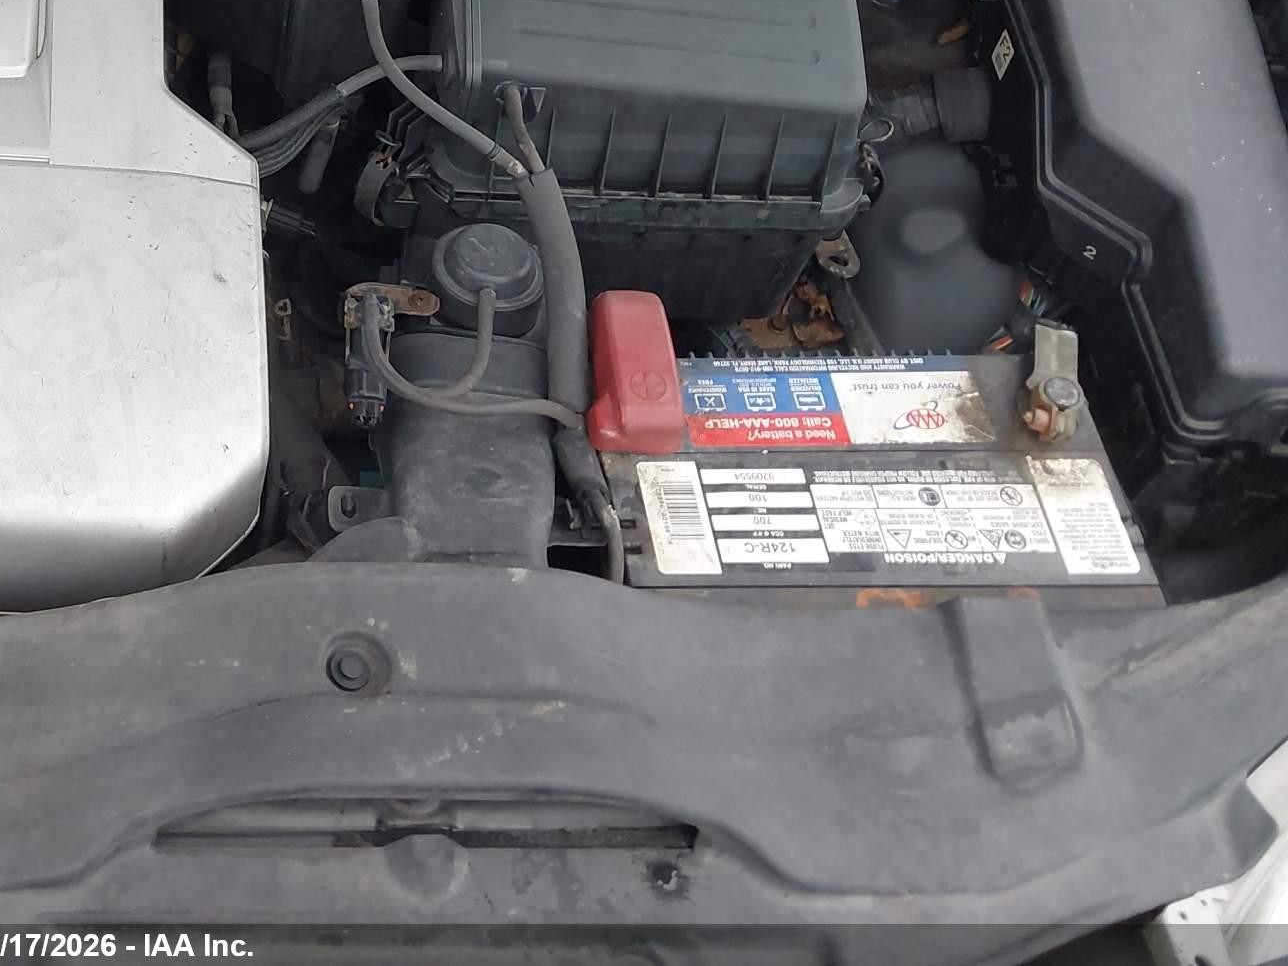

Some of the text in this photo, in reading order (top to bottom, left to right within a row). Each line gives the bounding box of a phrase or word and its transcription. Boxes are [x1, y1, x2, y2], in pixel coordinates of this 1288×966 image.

[1083, 245, 1097, 260] 2
[852, 384, 877, 392] trust
[904, 381, 923, 390] you
[927, 382, 961, 391] Power
[705, 417, 832, 428] Call: 800-AAA-HELP
[906, 409, 944, 429] AAA
[748, 429, 792, 440] battery?
[806, 430, 836, 440] Need
[749, 494, 767, 502] 100
[744, 542, 796, 553] 124R-C
[883, 553, 994, 563] DANGER/POISON
